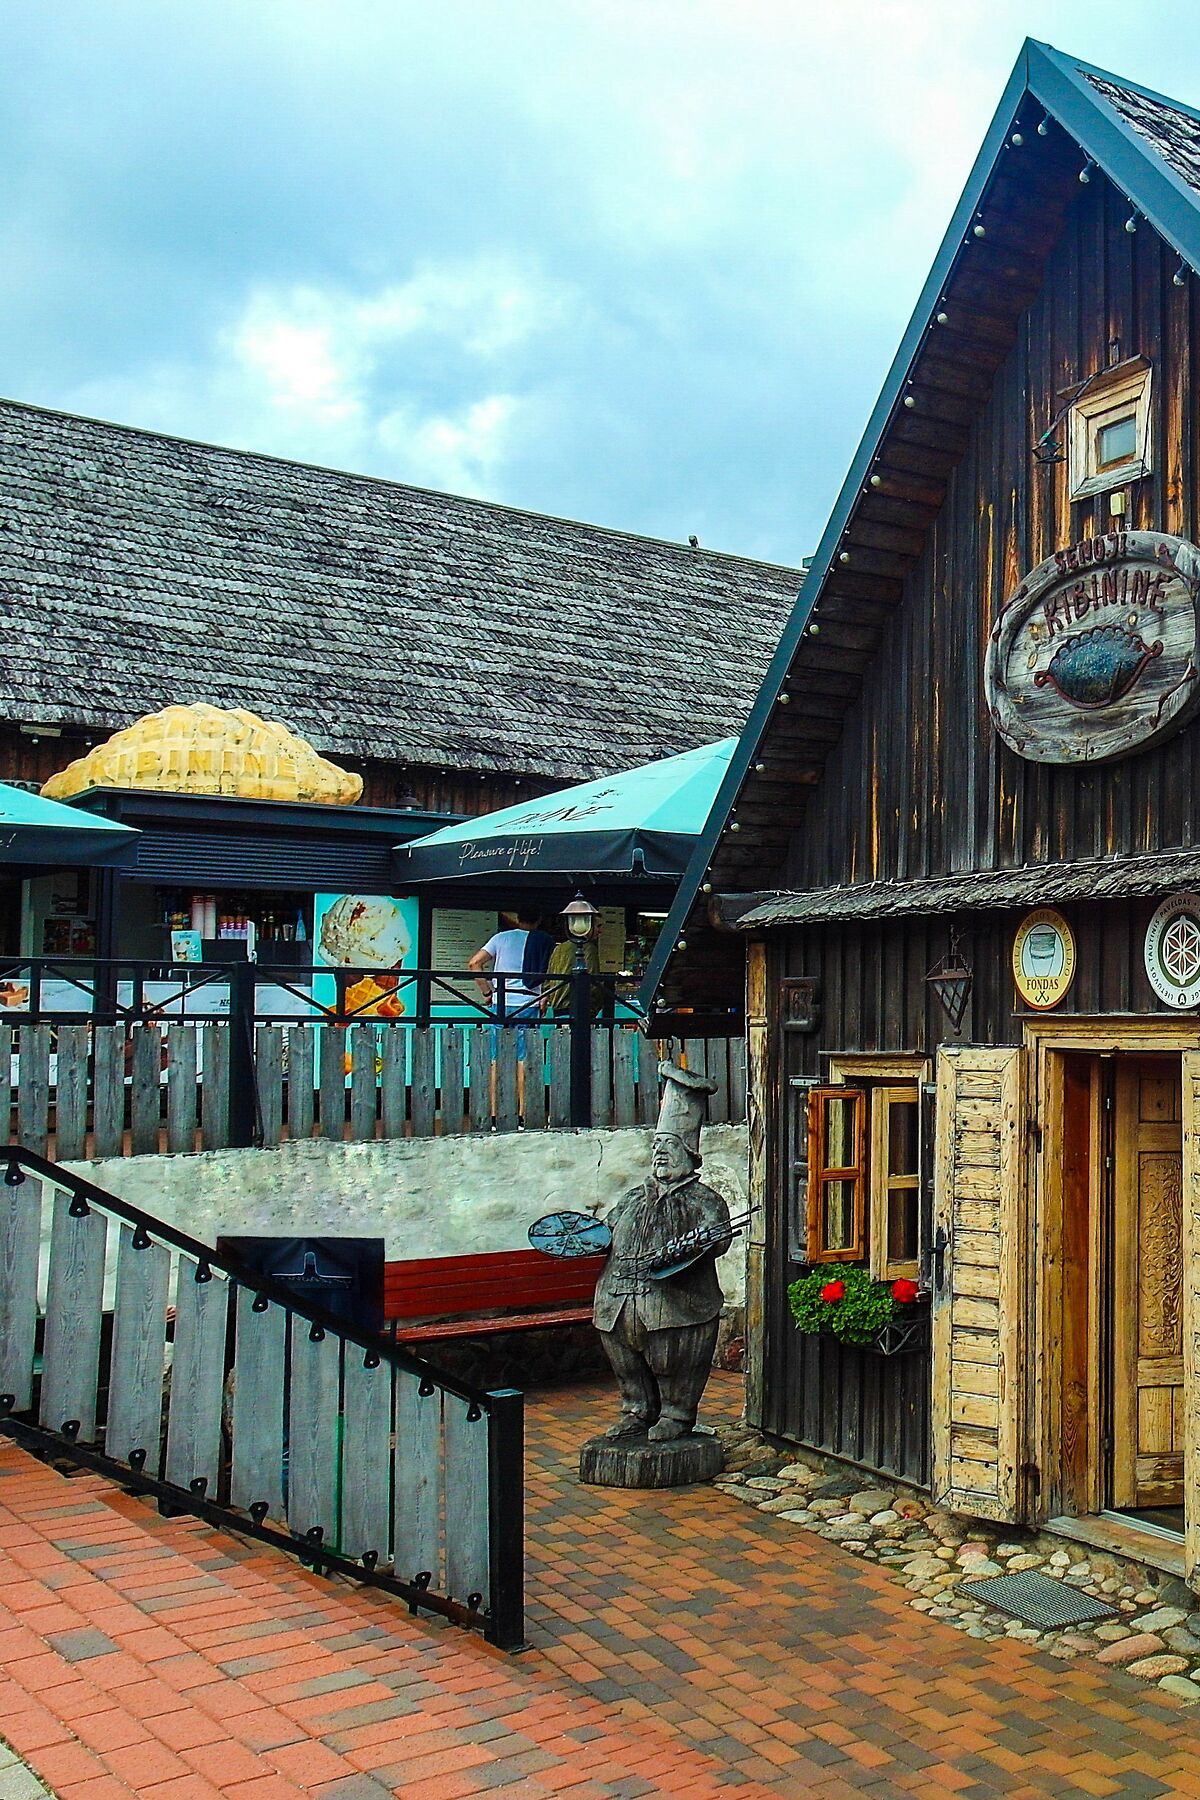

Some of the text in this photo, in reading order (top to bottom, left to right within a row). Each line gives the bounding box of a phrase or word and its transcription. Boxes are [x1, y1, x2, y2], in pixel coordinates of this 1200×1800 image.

[1054, 533, 1128, 575] SENOJI
[459, 840, 543, 866] Pleasure of life!
[1148, 898, 1191, 1001] LIETUVOS TAUTINIS PAVELDAS
[1026, 979, 1059, 990] FONDAS
